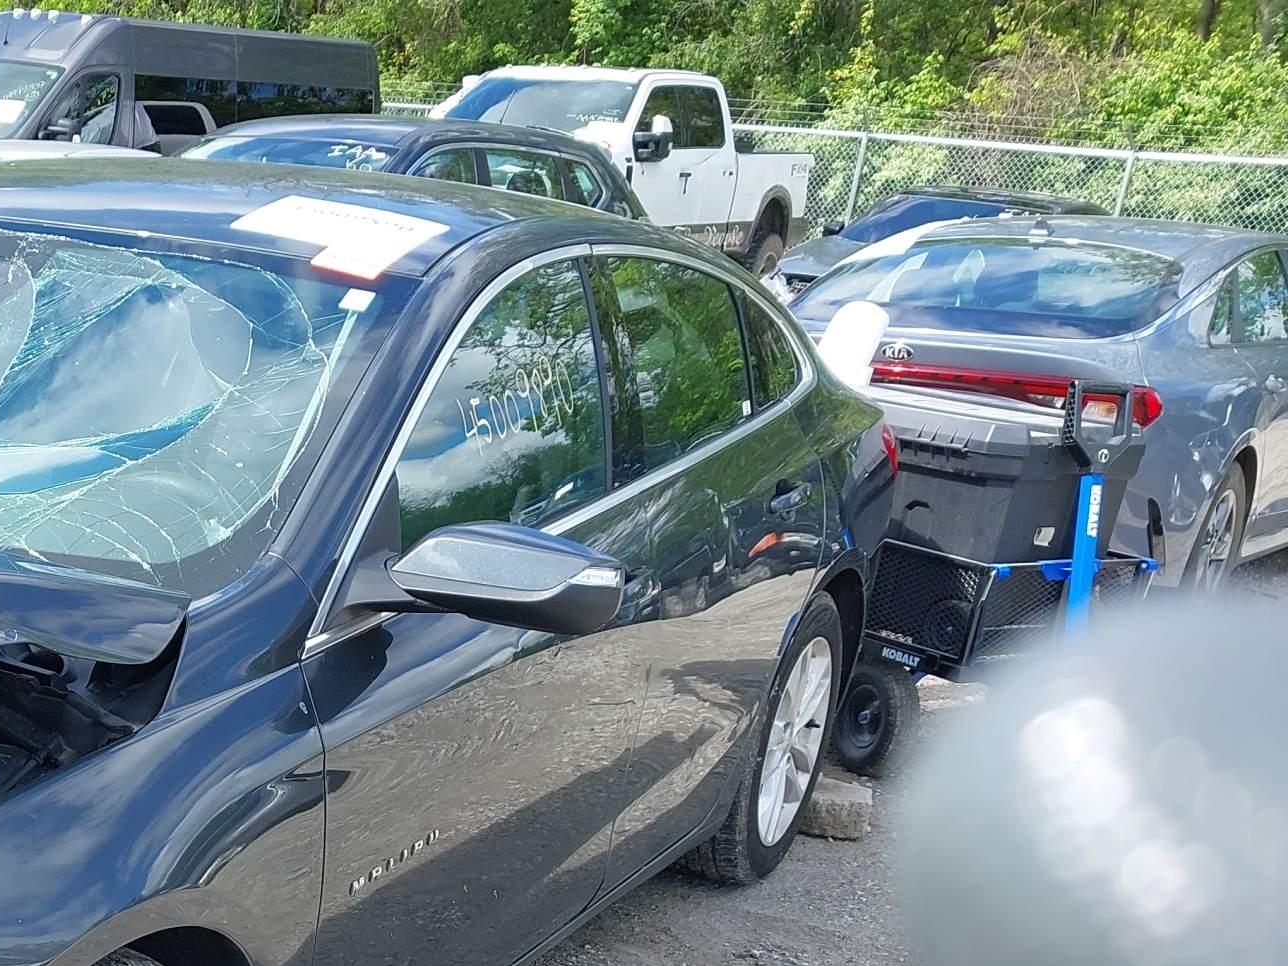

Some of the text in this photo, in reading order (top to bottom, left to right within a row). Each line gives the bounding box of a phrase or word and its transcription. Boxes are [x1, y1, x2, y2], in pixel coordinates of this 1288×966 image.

[456, 355, 574, 457] 45009890
[1086, 484, 1103, 538] KOBALT
[881, 646, 921, 667] KOBALT
[349, 828, 440, 896] MALIBU
